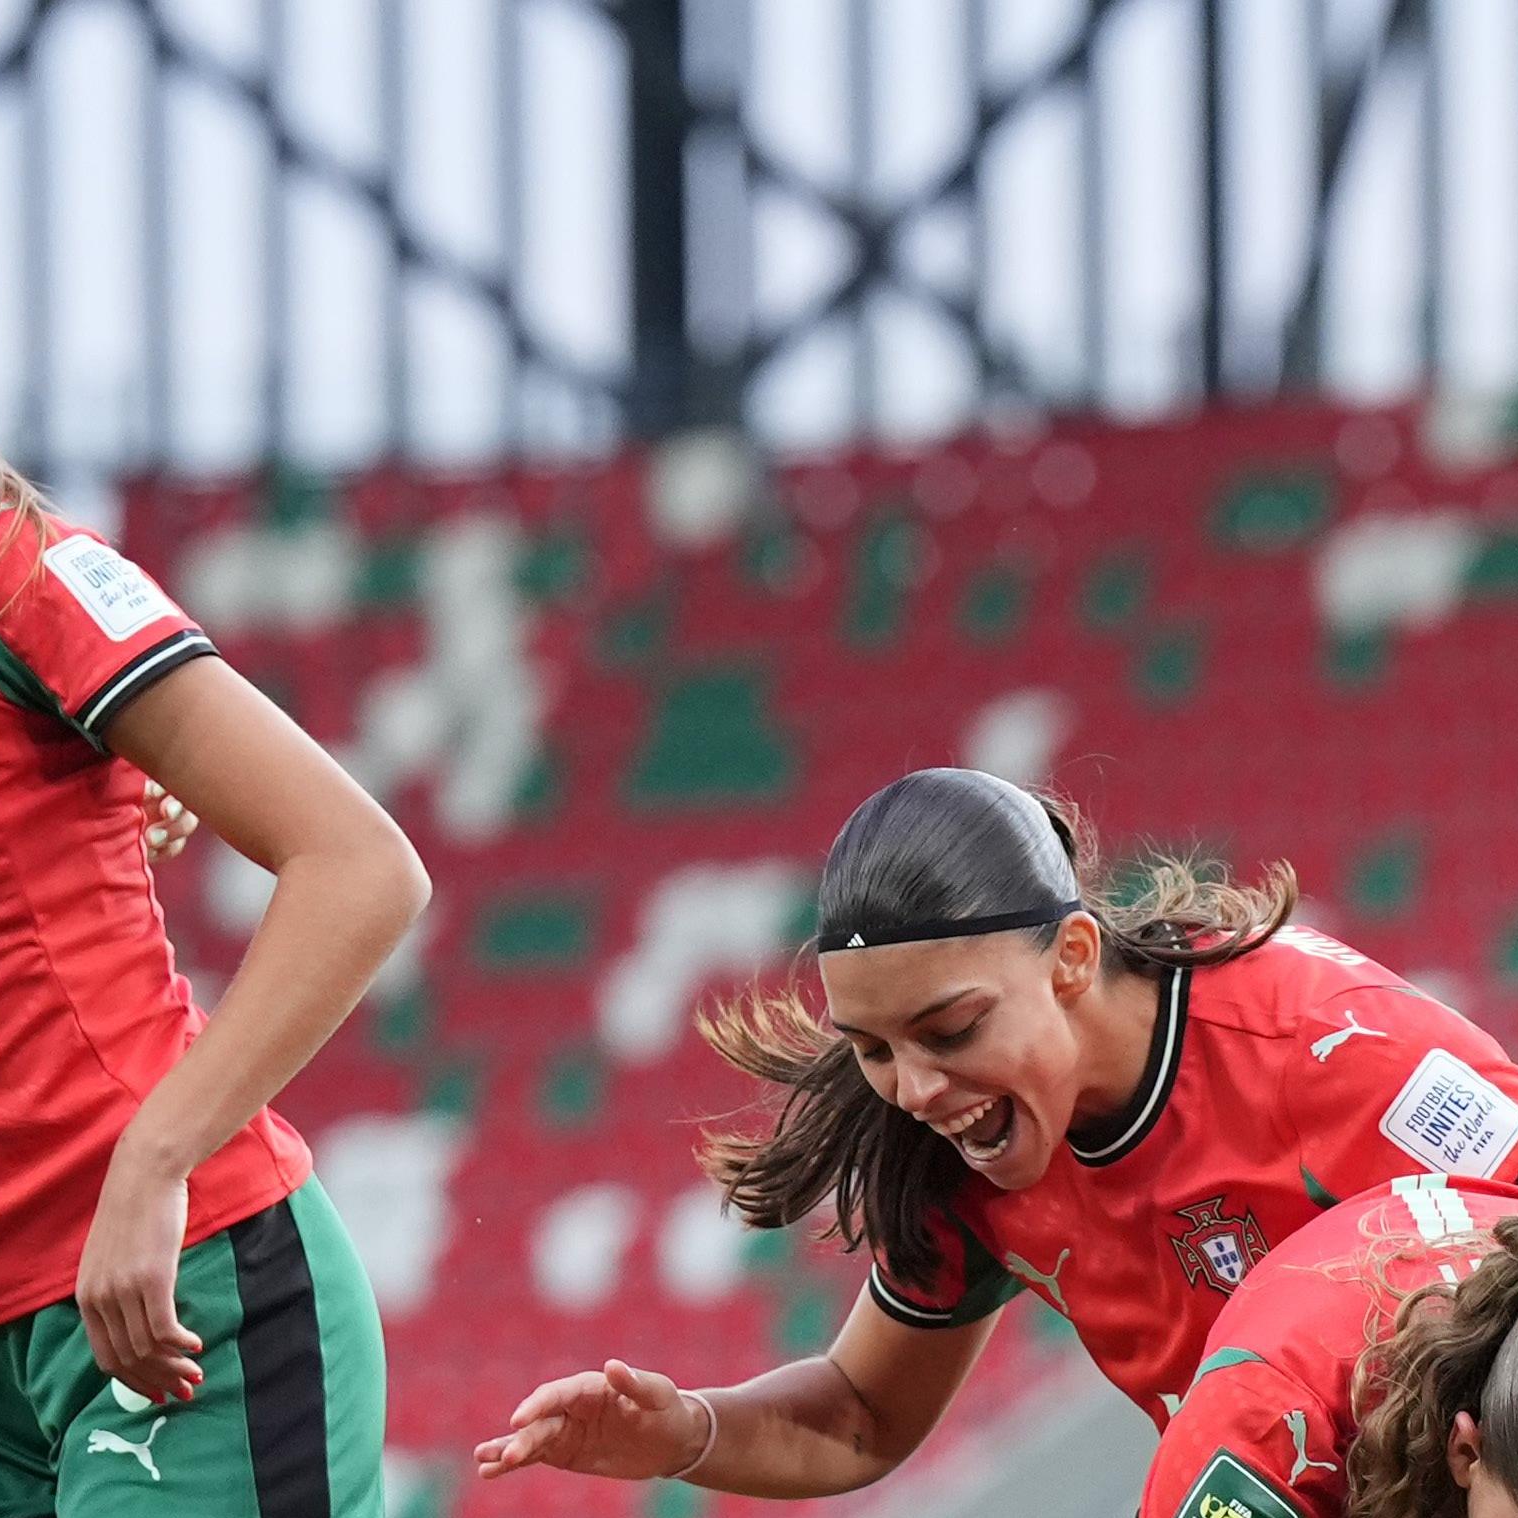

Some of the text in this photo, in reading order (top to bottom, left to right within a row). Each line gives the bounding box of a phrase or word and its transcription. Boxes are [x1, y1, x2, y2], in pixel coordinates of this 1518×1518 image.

[1405, 1074, 1455, 1134] FOOTBALL
[1420, 1084, 1475, 1147] UNITES
[1442, 1095, 1496, 1164] the World
[1472, 1129, 1495, 1155] FIFA
